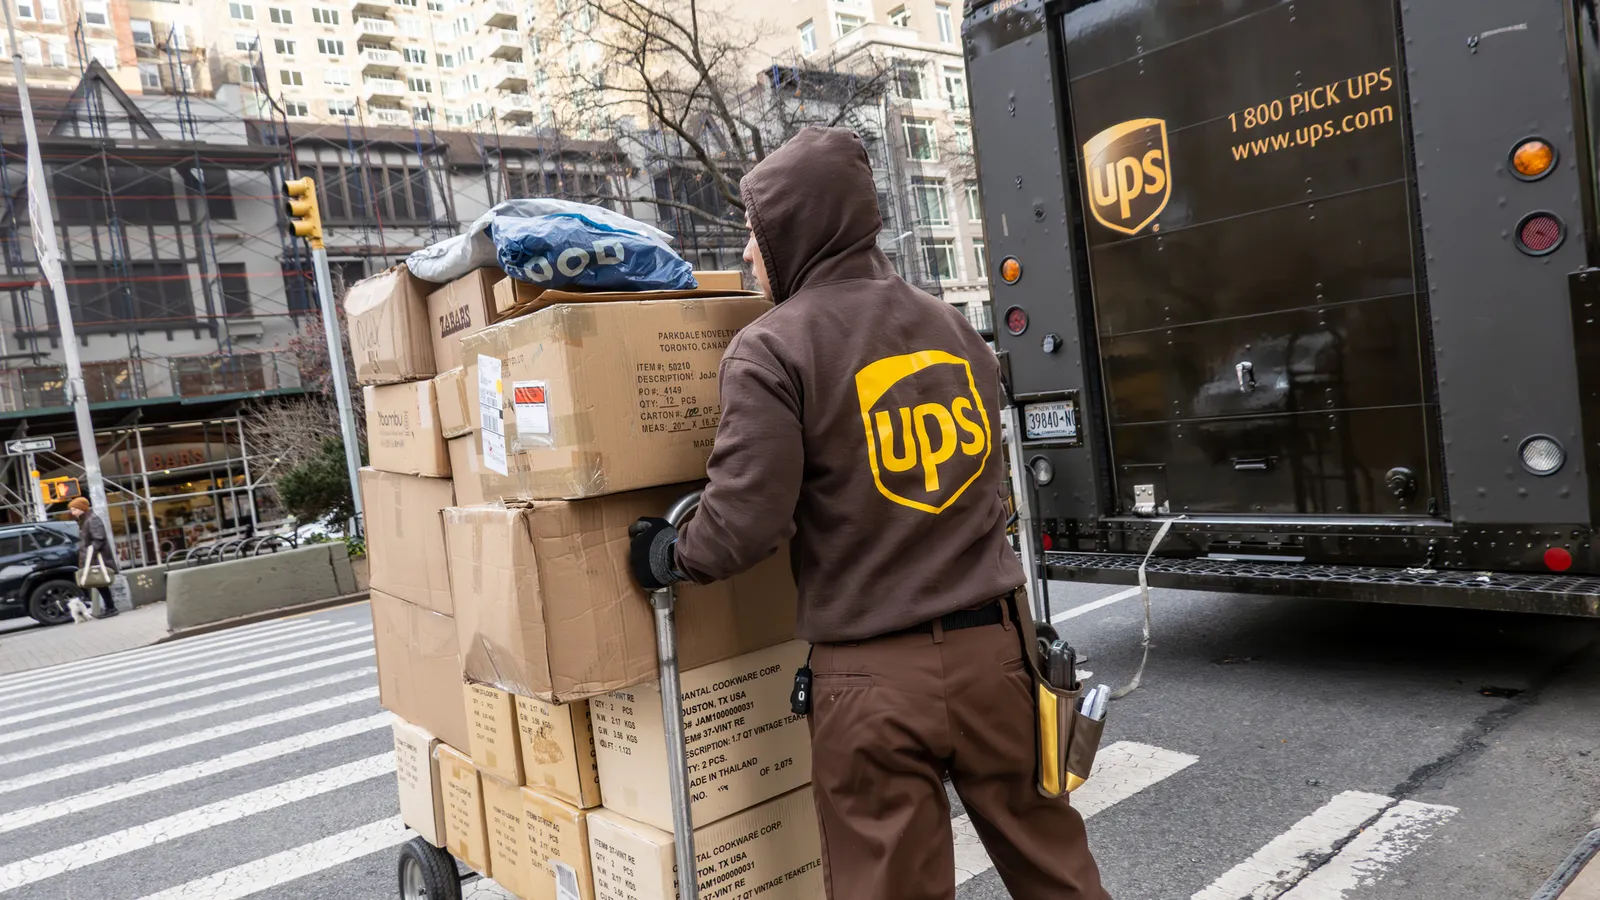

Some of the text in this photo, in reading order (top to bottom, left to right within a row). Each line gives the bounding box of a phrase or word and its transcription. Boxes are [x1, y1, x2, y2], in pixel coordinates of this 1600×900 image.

[1228, 67, 1394, 133] 1 800 PICK UPS
[1232, 104, 1394, 161] www.ups.com
[658, 331, 700, 340] PARKDALE
[702, 329, 734, 339] NOVELTY
[660, 342, 730, 352] TORONTO, CANAD
[636, 363, 656, 372] ITEM
[668, 362, 690, 371] 50210
[699, 372, 716, 380] JoJo
[638, 388, 650, 396] PO
[664, 386, 682, 395] 4149
[640, 396, 696, 408] QTY: 12 PCS
[640, 411, 674, 420] CARTON
[702, 406, 713, 415] OF
[642, 424, 668, 433] MEAS:
[694, 438, 714, 448] MADE
[875, 396, 985, 492] ups
[680, 664, 782, 702] HANTAL COOKWARE CORP.
[627, 694, 635, 702] RE
[682, 690, 746, 717] OUSTON, TX USA
[622, 706, 634, 716] PCS
[695, 701, 754, 726] JAM1000000031
[624, 720, 636, 730] KGS
[685, 717, 745, 744] EM# 37-VINT RE
[626, 734, 638, 744] KGS
[685, 714, 806, 759] ESCRIPTION: 1.7 QT VINTAGE TEAKE
[687, 754, 727, 774] TY: 2 PCS.
[690, 776, 707, 788] ADE
[709, 772, 717, 781] IN
[718, 757, 758, 778] THAILAND
[691, 757, 793, 803] /NO. OF 2,075
[713, 830, 759, 856] COOKWARE
[760, 820, 783, 835] CORP.
[628, 855, 635, 865] RE
[718, 859, 729, 869] TX
[730, 852, 747, 864] USA
[623, 866, 634, 877] PCS
[734, 878, 746, 890] RE
[743, 858, 822, 900] QT VINTAGE TEAKETTLE
[624, 880, 636, 891] KGS
